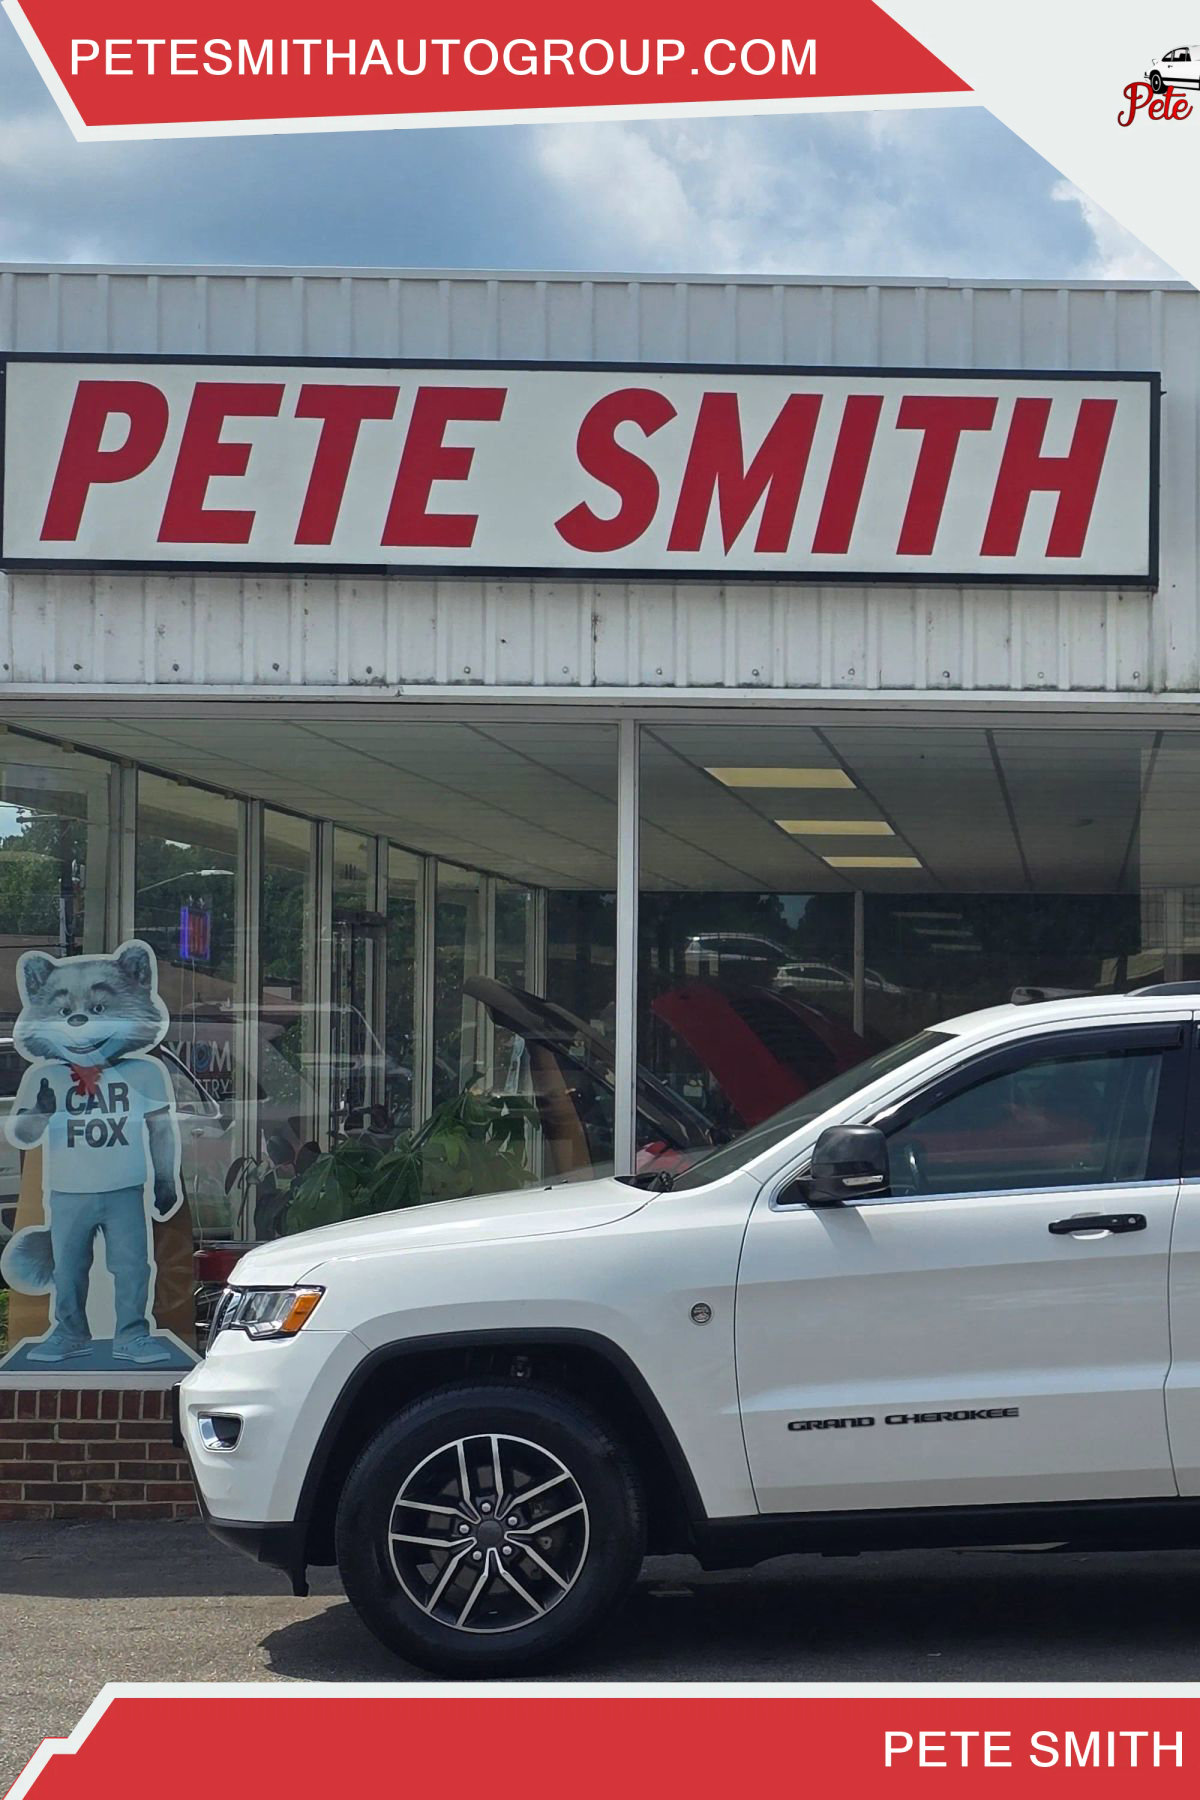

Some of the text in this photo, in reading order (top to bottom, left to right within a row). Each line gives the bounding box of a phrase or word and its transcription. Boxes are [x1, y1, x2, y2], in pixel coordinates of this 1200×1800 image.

[39, 379, 1117, 557] PETE SMITH
[65, 1081, 130, 1116] CAR
[66, 1116, 130, 1149] FOX
[787, 1406, 1020, 1433] GRAND CHEROKEE
